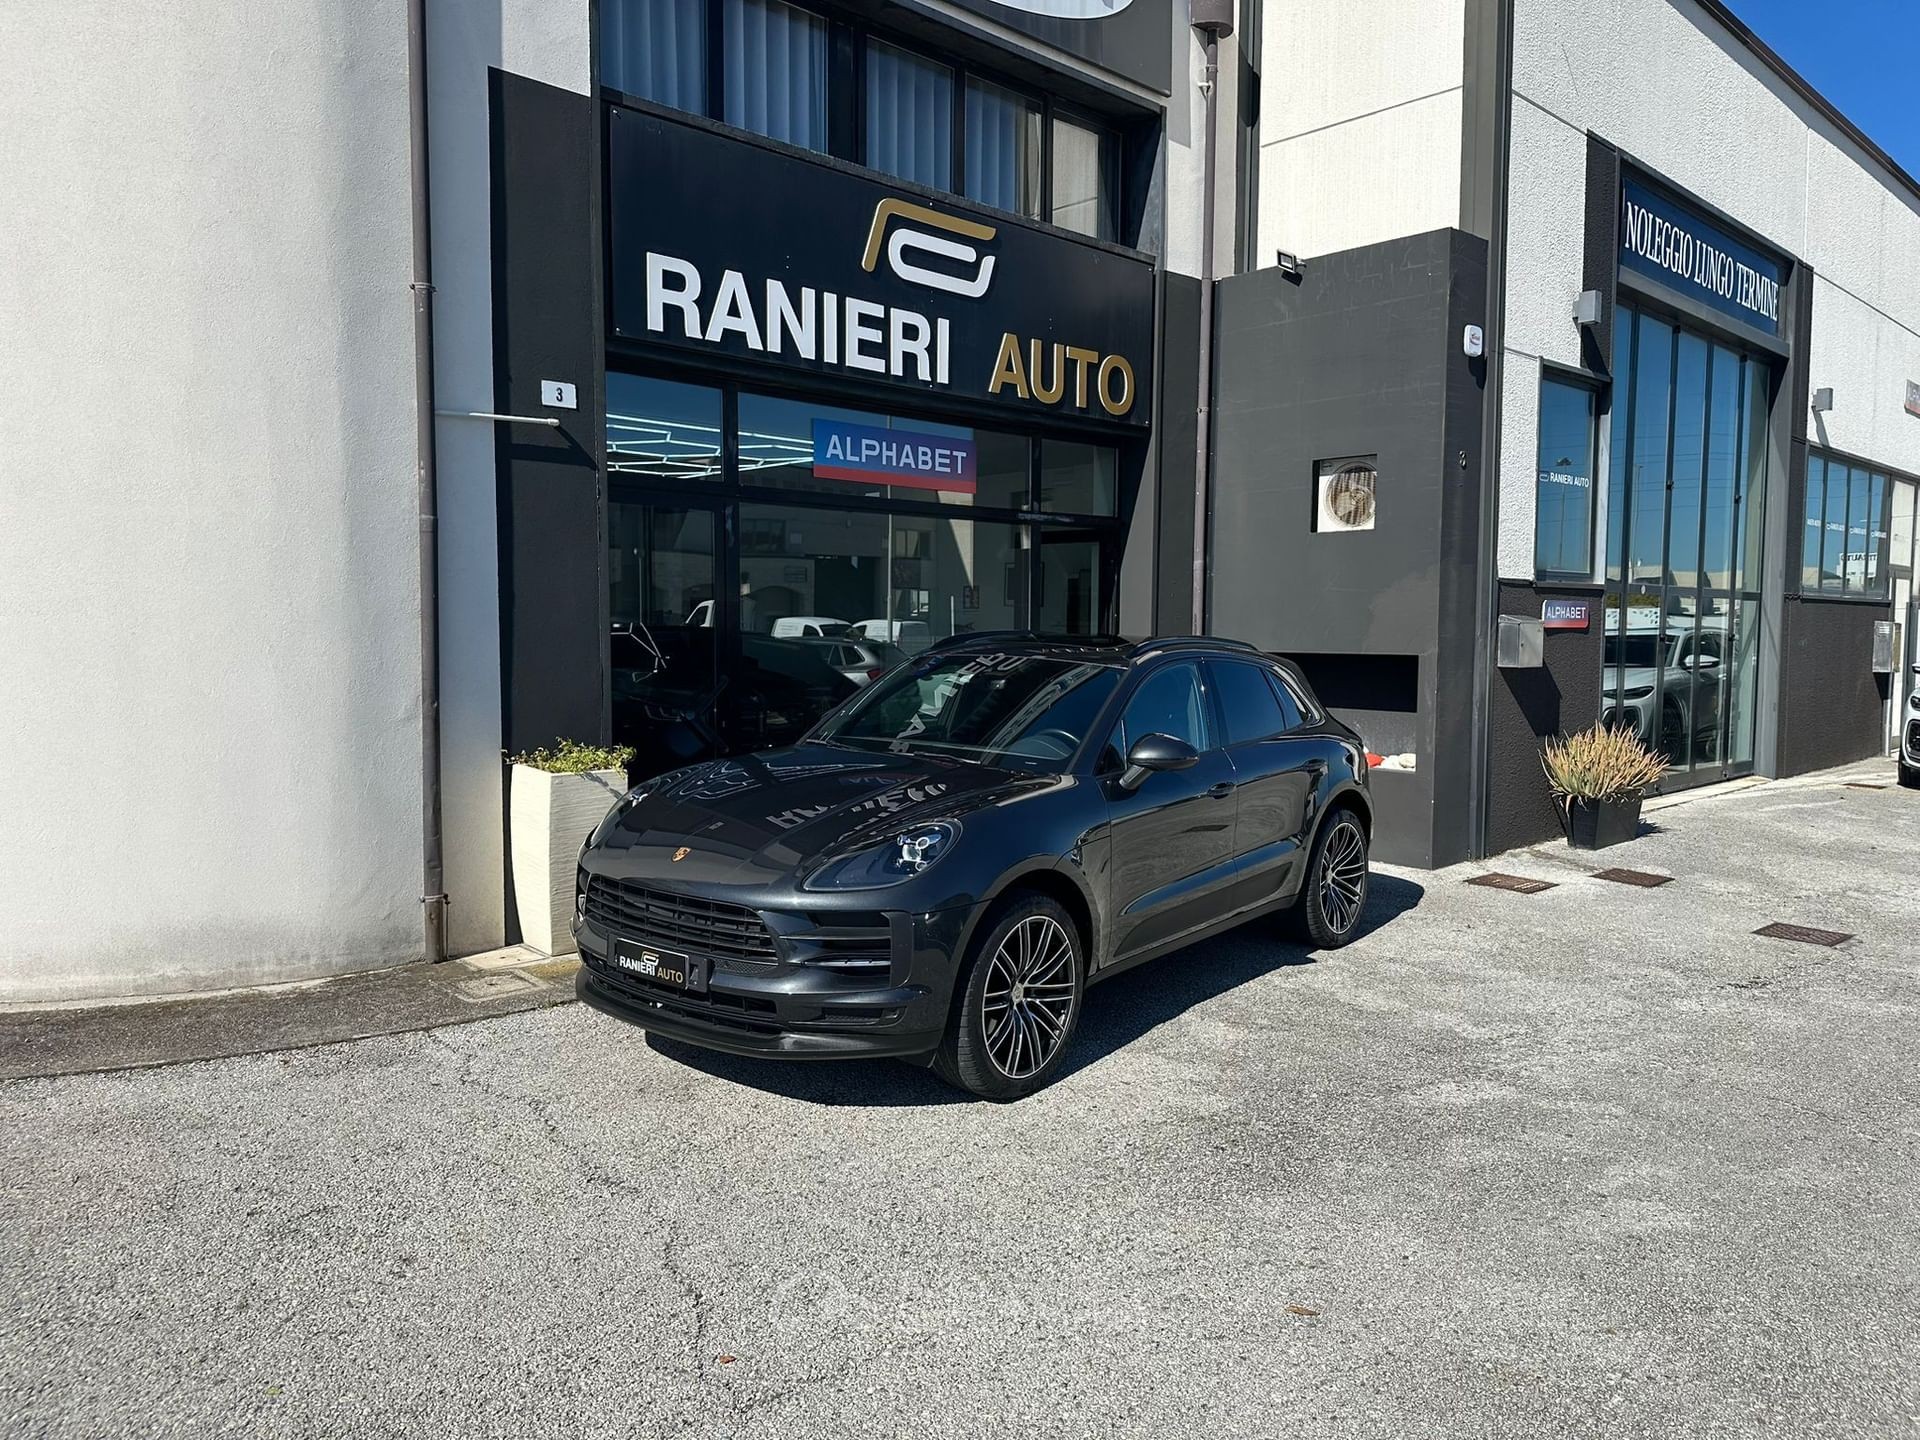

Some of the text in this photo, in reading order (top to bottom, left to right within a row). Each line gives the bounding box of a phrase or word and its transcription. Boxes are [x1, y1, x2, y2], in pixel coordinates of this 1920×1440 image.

[1625, 201, 1779, 322] NOLEGGIO LUNGO TERMINE
[645, 251, 1135, 416] RANIERI AUTO
[556, 387, 563, 402] 3
[826, 434, 967, 474] ALPHABET
[1550, 472, 1590, 488] RANIERI AUTO
[1546, 606, 1586, 619] ALPHABET
[619, 955, 684, 983] RANIERI AUTO
